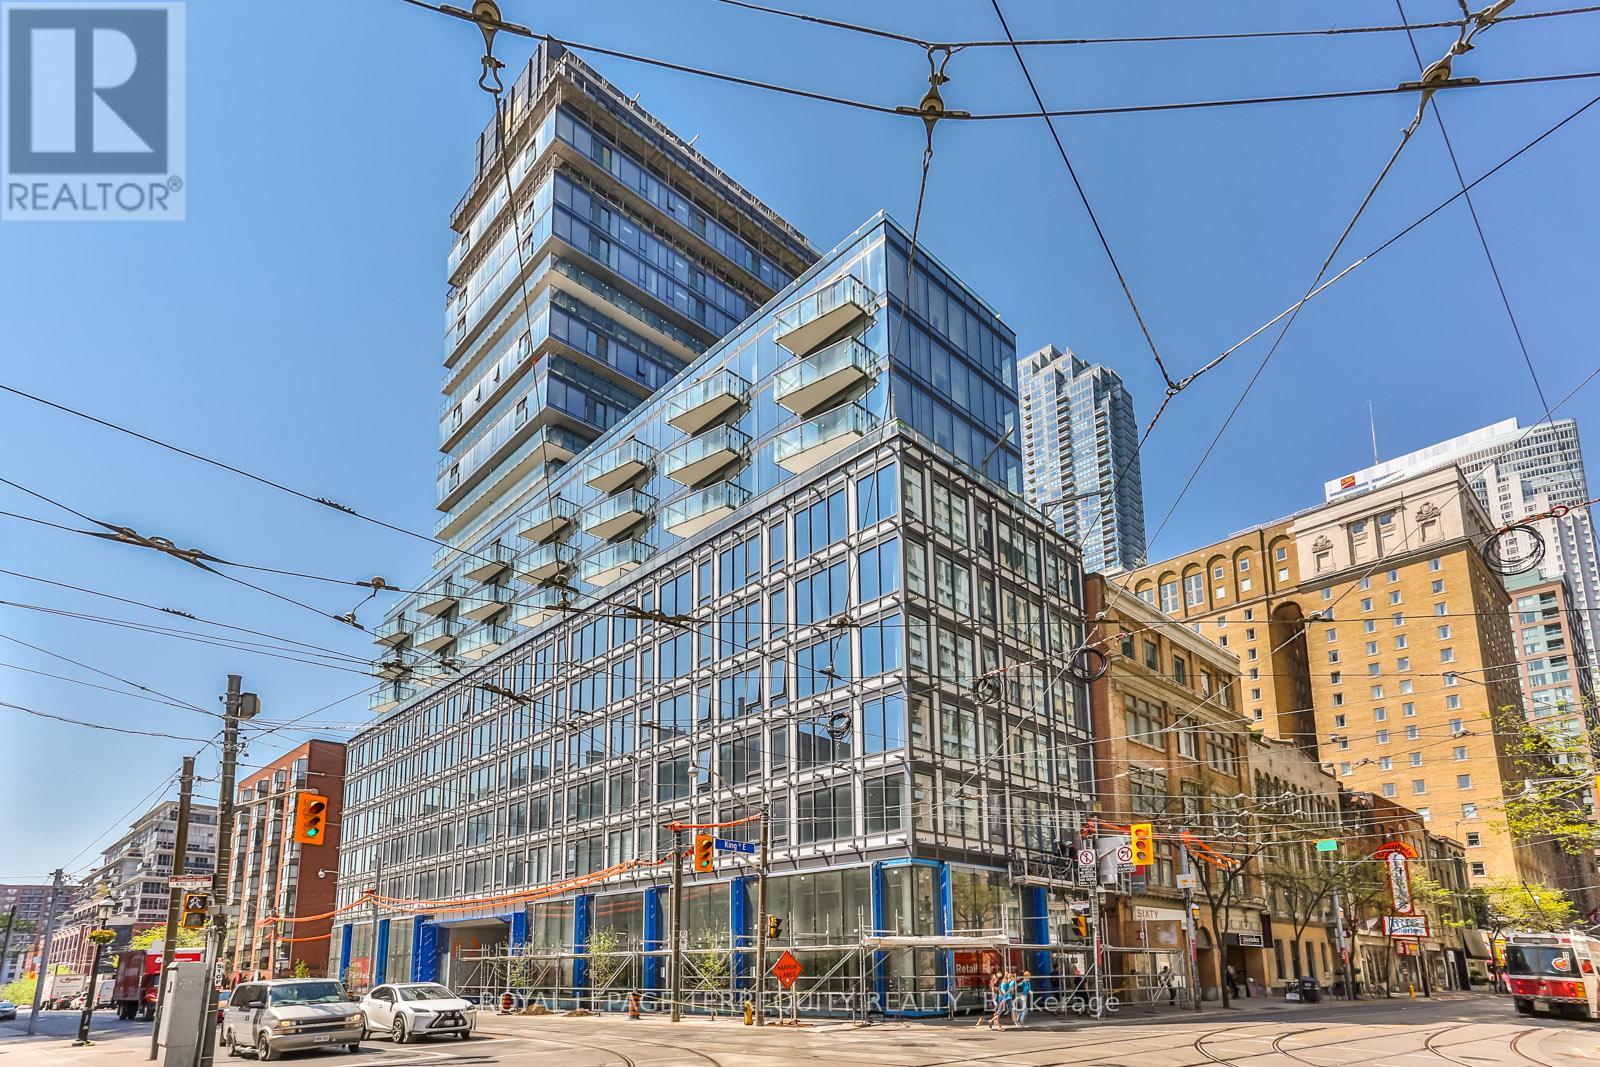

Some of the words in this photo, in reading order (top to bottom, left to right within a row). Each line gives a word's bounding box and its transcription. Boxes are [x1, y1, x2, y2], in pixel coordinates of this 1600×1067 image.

[724, 840, 738, 851] King
[742, 843, 748, 851] E
[1137, 909, 1158, 919] SIXTY
[955, 963, 978, 974] Retail
